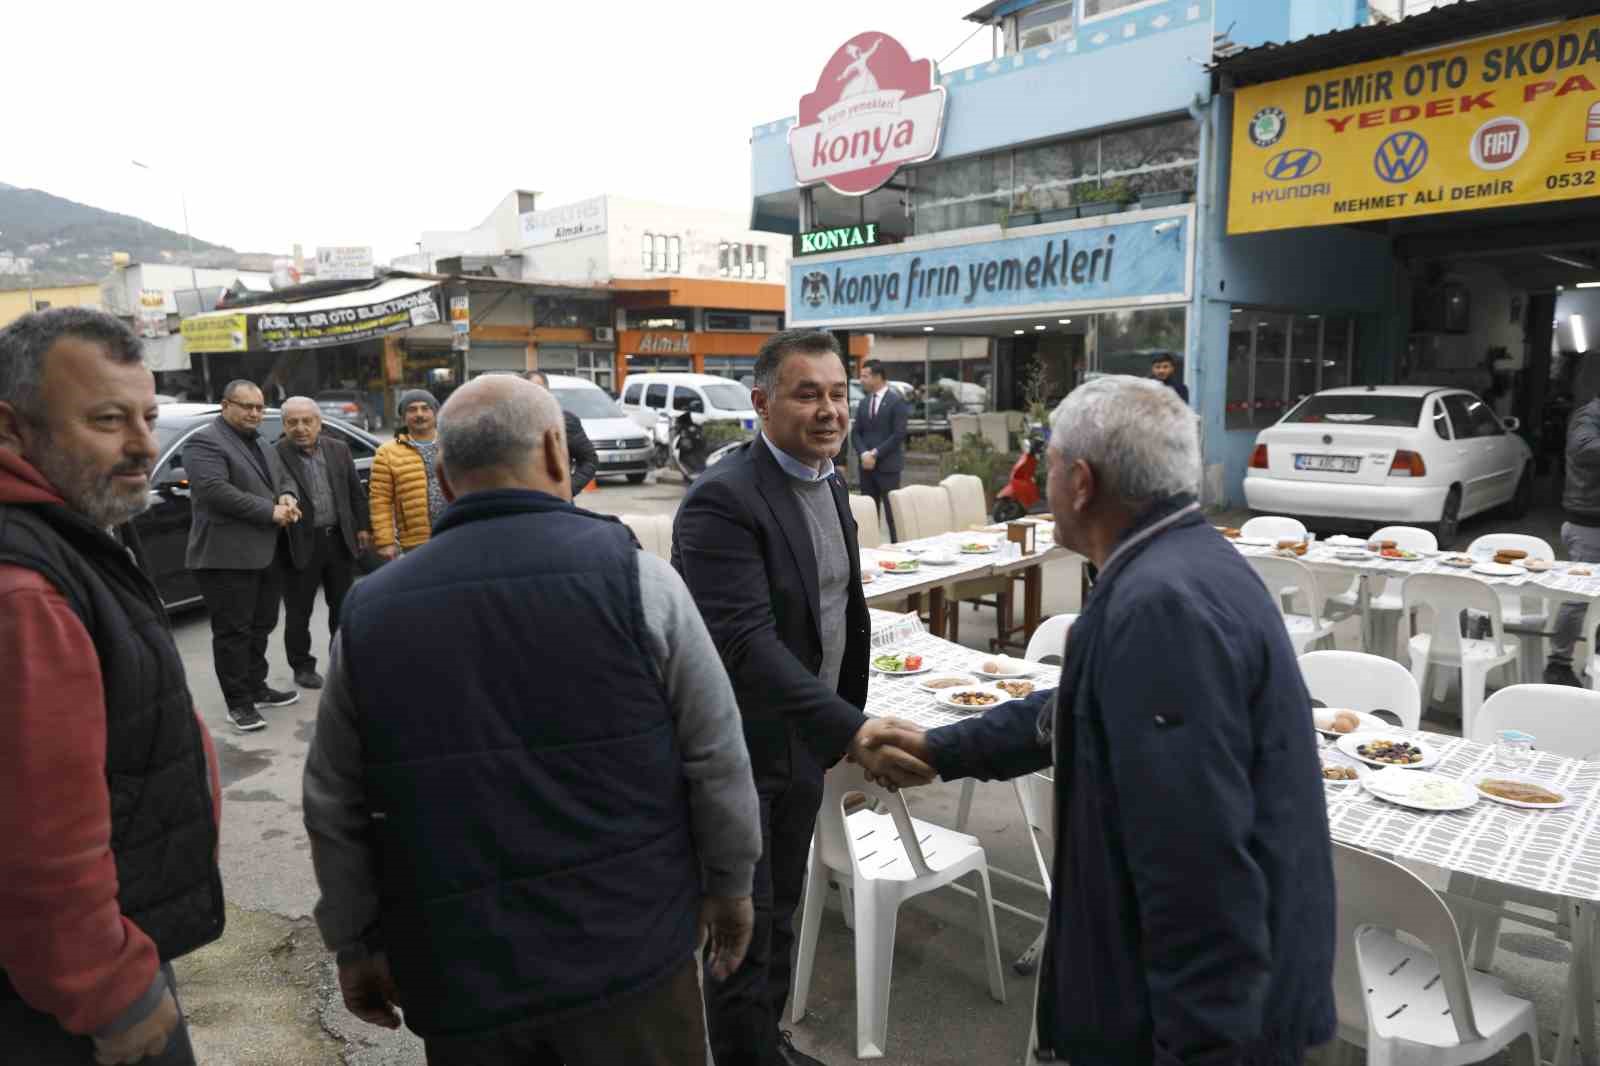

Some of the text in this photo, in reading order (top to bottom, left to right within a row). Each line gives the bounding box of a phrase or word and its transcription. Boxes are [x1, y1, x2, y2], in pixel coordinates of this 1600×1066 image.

[1402, 55, 1468, 97] OTO
[1481, 28, 1600, 83] SKODA
[1325, 90, 1497, 134] YEDEK
[811, 118, 915, 168] konya
[1483, 130, 1517, 157] FIAT
[1251, 183, 1331, 205] HYUNDAI
[1333, 178, 1513, 214] MEHMET ALİ DEMİR
[1546, 170, 1596, 190] 0532
[801, 226, 864, 253] KONYA
[832, 233, 1116, 309] konya fırın yemekleri
